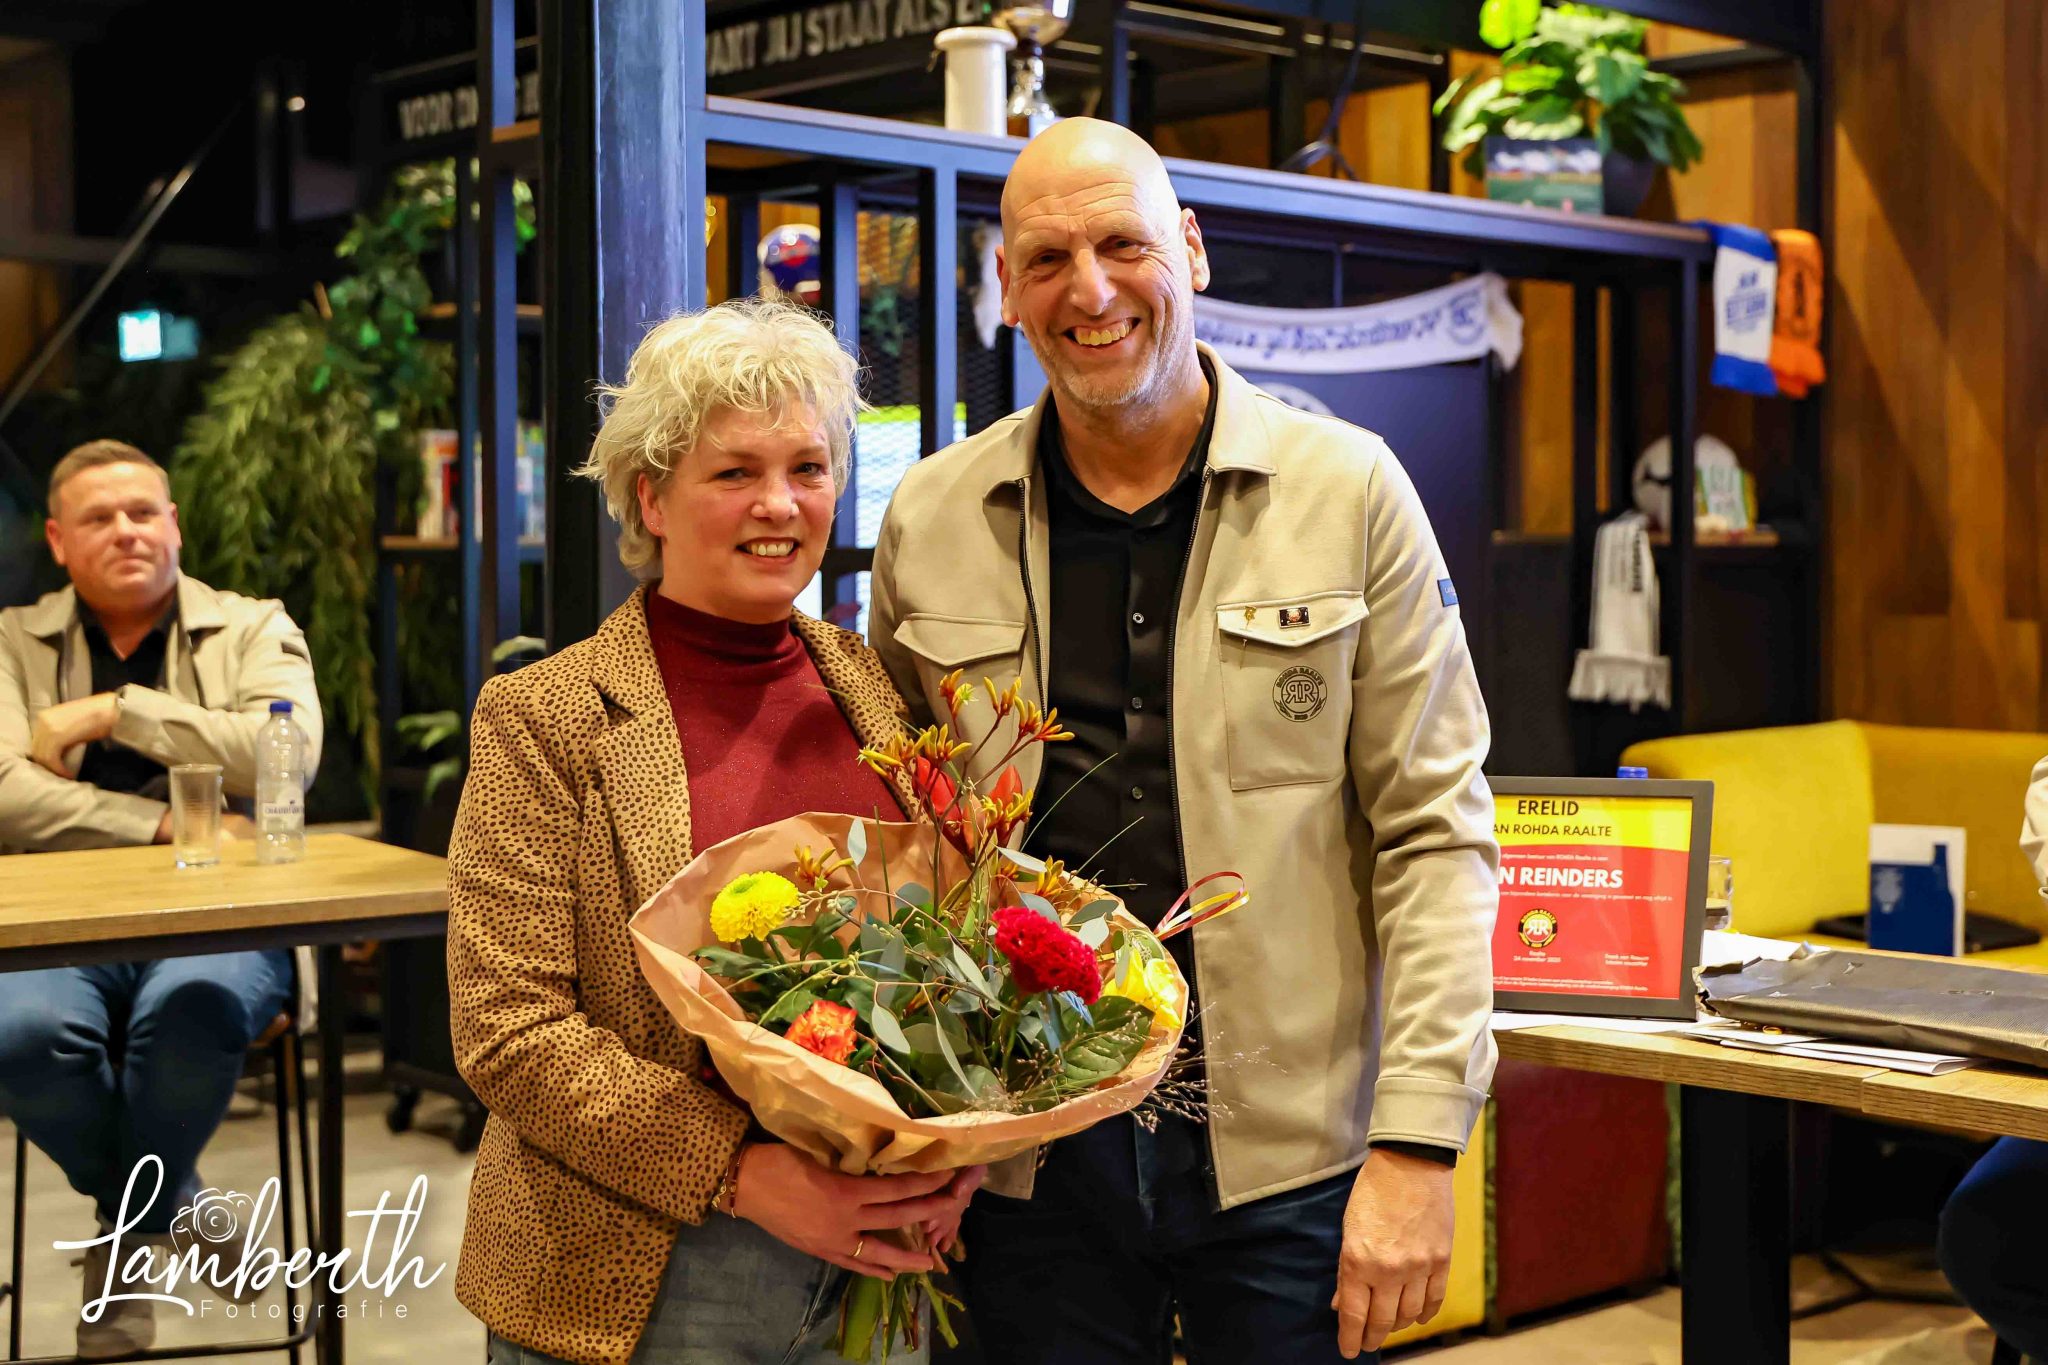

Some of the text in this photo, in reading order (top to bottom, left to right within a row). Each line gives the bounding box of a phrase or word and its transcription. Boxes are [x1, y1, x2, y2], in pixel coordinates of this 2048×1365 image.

[705, 22, 760, 77] AKT
[805, 0, 888, 57] STAAT
[1517, 799, 1579, 816] ERELID
[1493, 823, 1612, 837] AN ROHDA RAALTE
[1519, 867, 1624, 889] REINDERS
